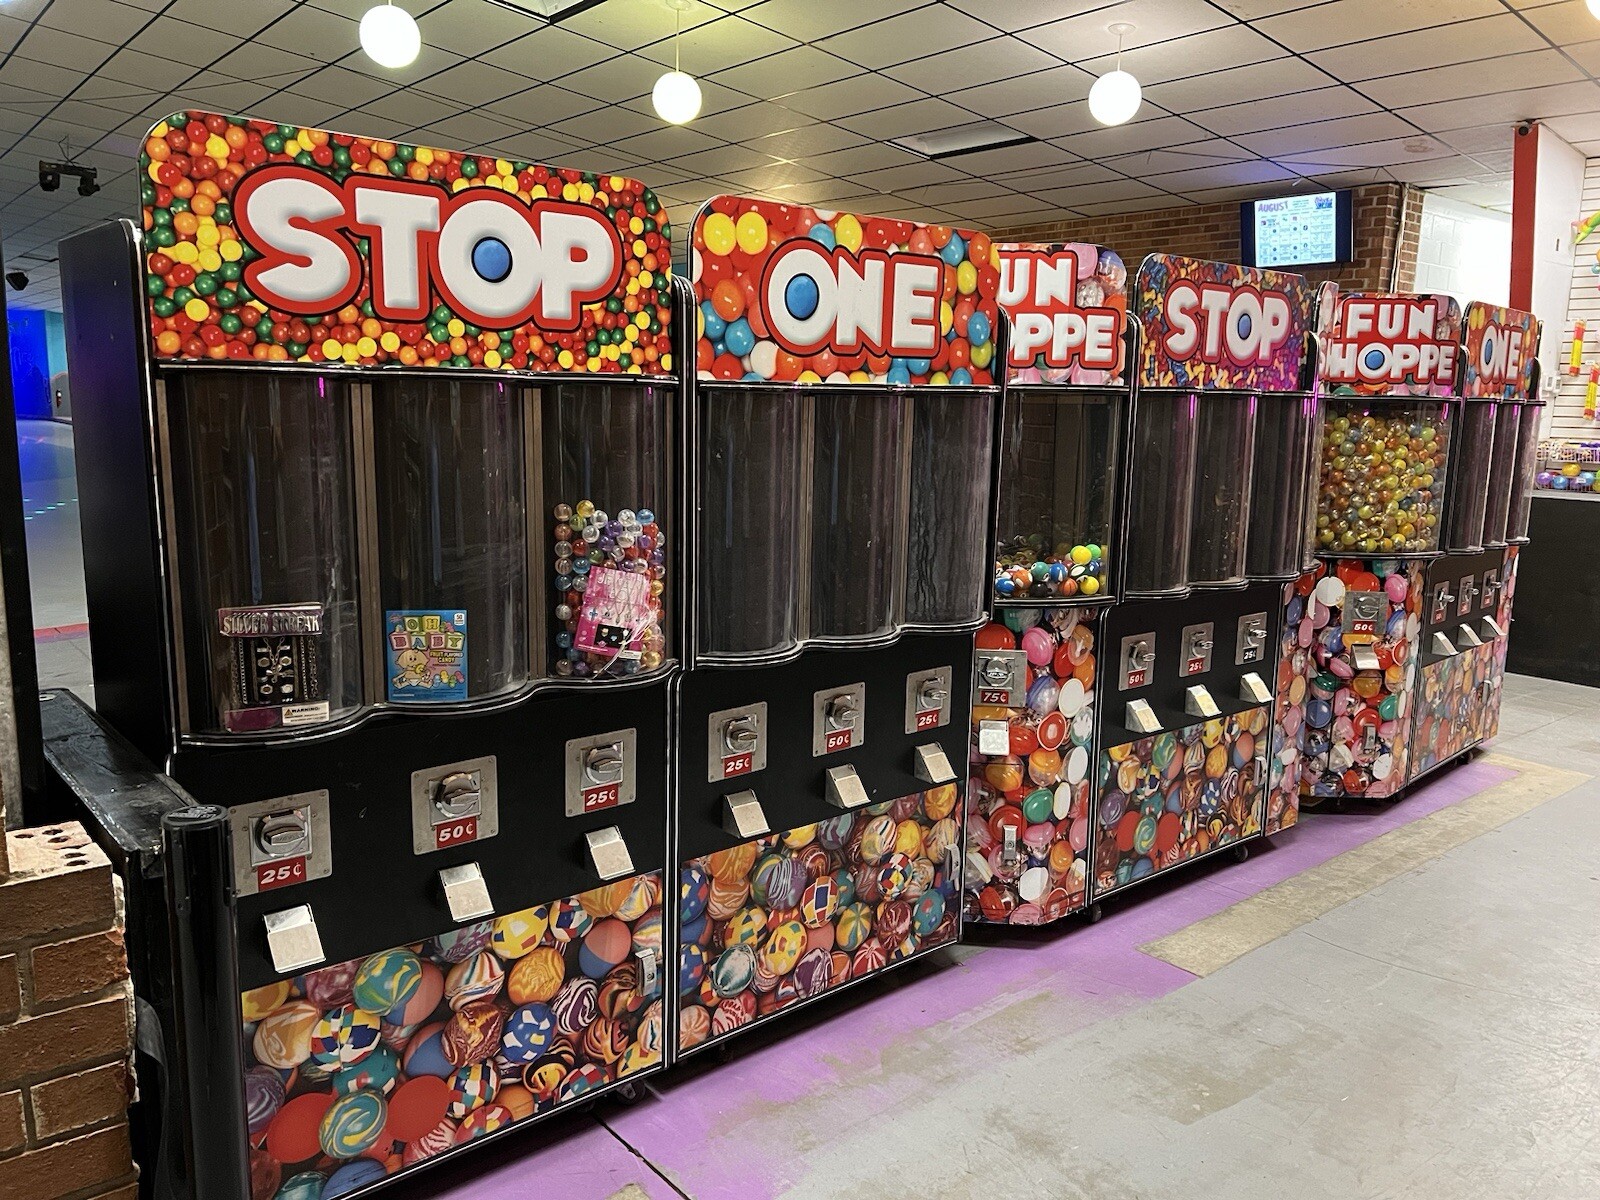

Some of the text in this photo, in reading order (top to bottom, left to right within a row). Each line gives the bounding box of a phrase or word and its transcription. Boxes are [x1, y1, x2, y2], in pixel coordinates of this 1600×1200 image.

[1257, 200, 1289, 213] AUGUST
[246, 177, 615, 320] STOP
[996, 257, 1072, 307] UN
[768, 248, 939, 350] ONE
[1166, 286, 1290, 360] STOP
[1346, 303, 1436, 340] FUN
[1009, 313, 1116, 362] PPE
[1480, 324, 1523, 381] ONE
[223, 612, 320, 634] SILVER STREAK
[407, 618, 439, 630] OH
[393, 636, 462, 649] BABY
[983, 692, 1008, 703] 75¢
[917, 713, 938, 727] 25¢
[828, 734, 850, 748] 50¢
[725, 757, 750, 773] 25¢
[586, 789, 616, 807] 25¢
[438, 822, 475, 842] 50¢
[260, 862, 302, 885] 25¢
